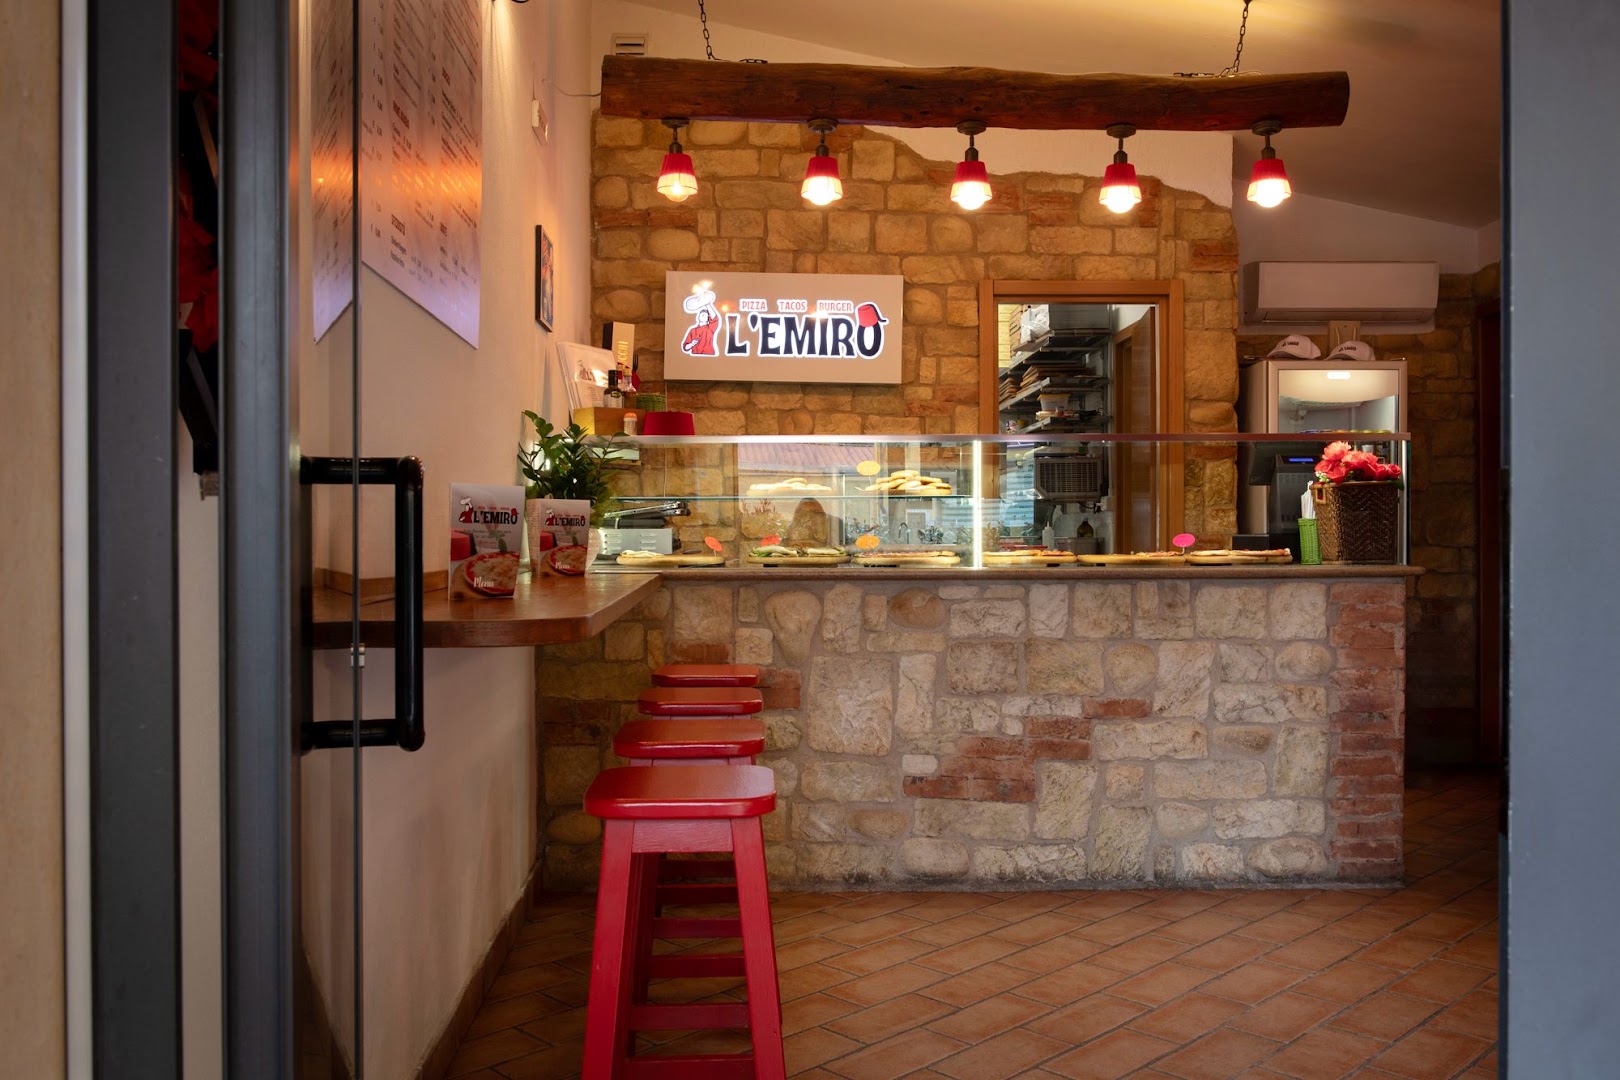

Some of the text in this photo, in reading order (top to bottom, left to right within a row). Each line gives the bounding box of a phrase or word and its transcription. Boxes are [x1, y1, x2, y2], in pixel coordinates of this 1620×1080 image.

[742, 301, 852, 312] PIZZA TACOS BURGER
[727, 314, 883, 357] L'EMIRO
[473, 511, 518, 525] L'EMIRO
[554, 517, 586, 527] L'EMIRO
[473, 576, 495, 588] Menu
